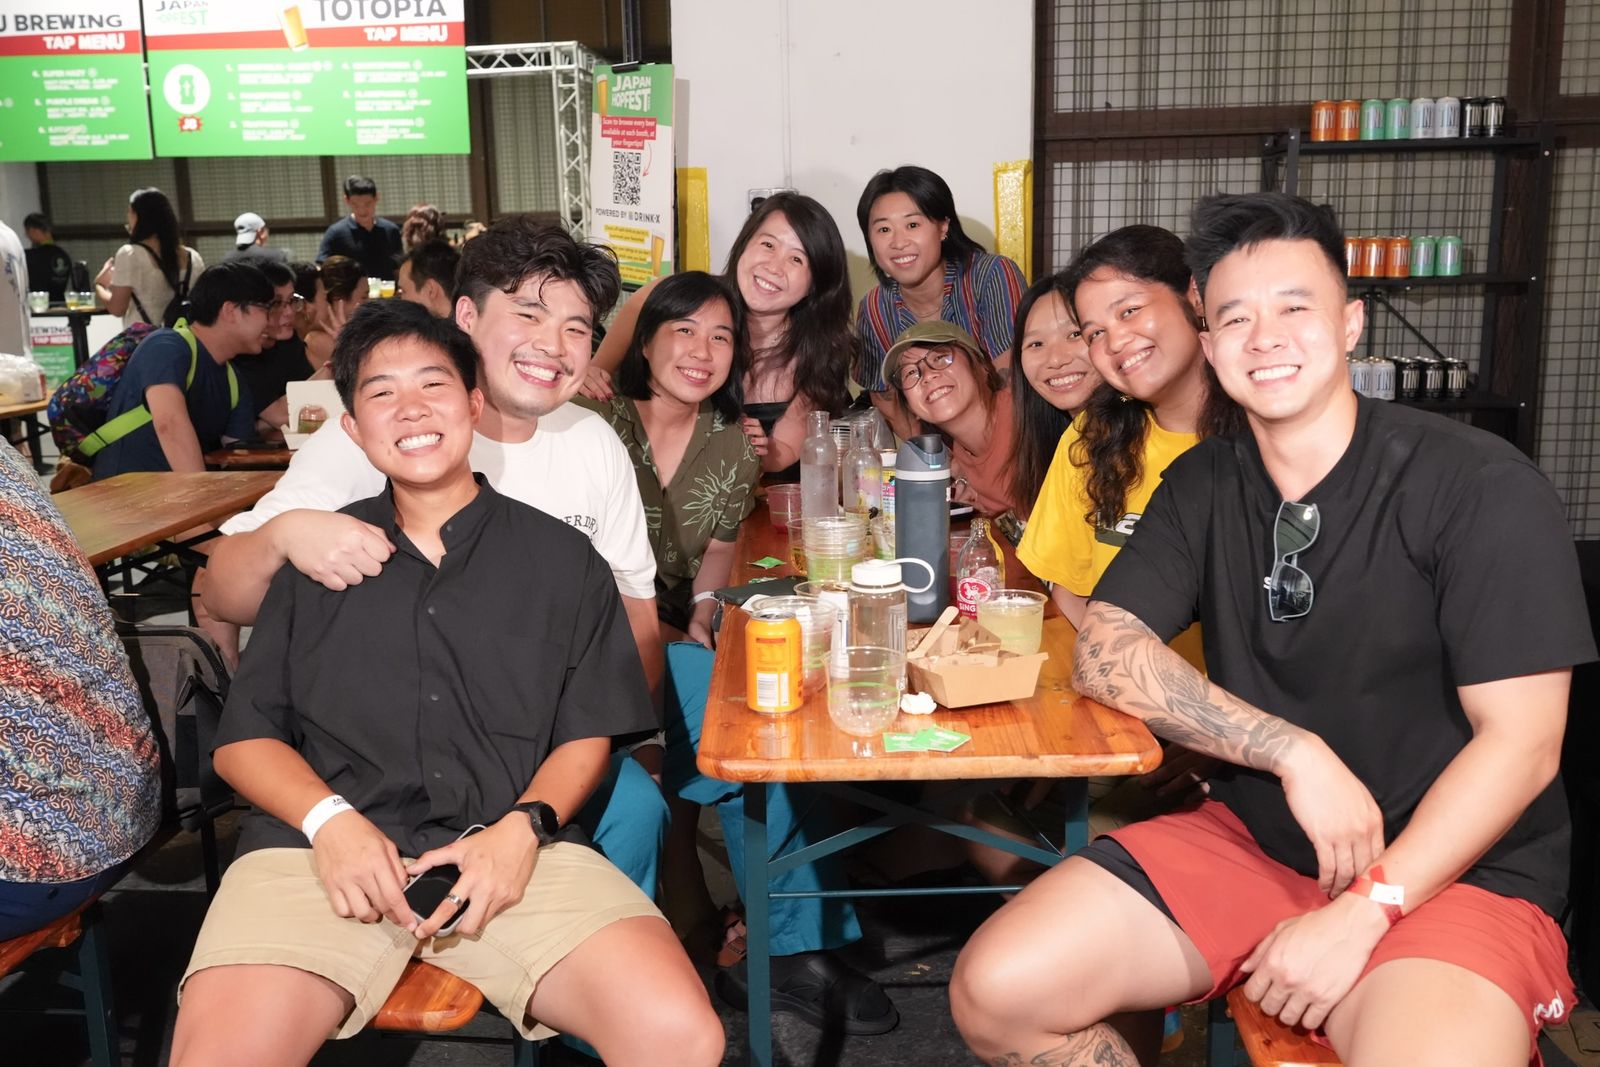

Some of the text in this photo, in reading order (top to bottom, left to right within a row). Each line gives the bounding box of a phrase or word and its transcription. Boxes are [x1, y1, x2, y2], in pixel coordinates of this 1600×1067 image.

[310, 0, 447, 21] TOTOPIA
[14, 14, 122, 31] BREWING
[42, 33, 126, 50] TAP MENU
[363, 24, 449, 42] TAP MENU
[611, 75, 652, 92] JAPAN
[611, 87, 652, 112] HOPFEST
[595, 207, 620, 218] POWERED
[621, 211, 627, 219] BY
